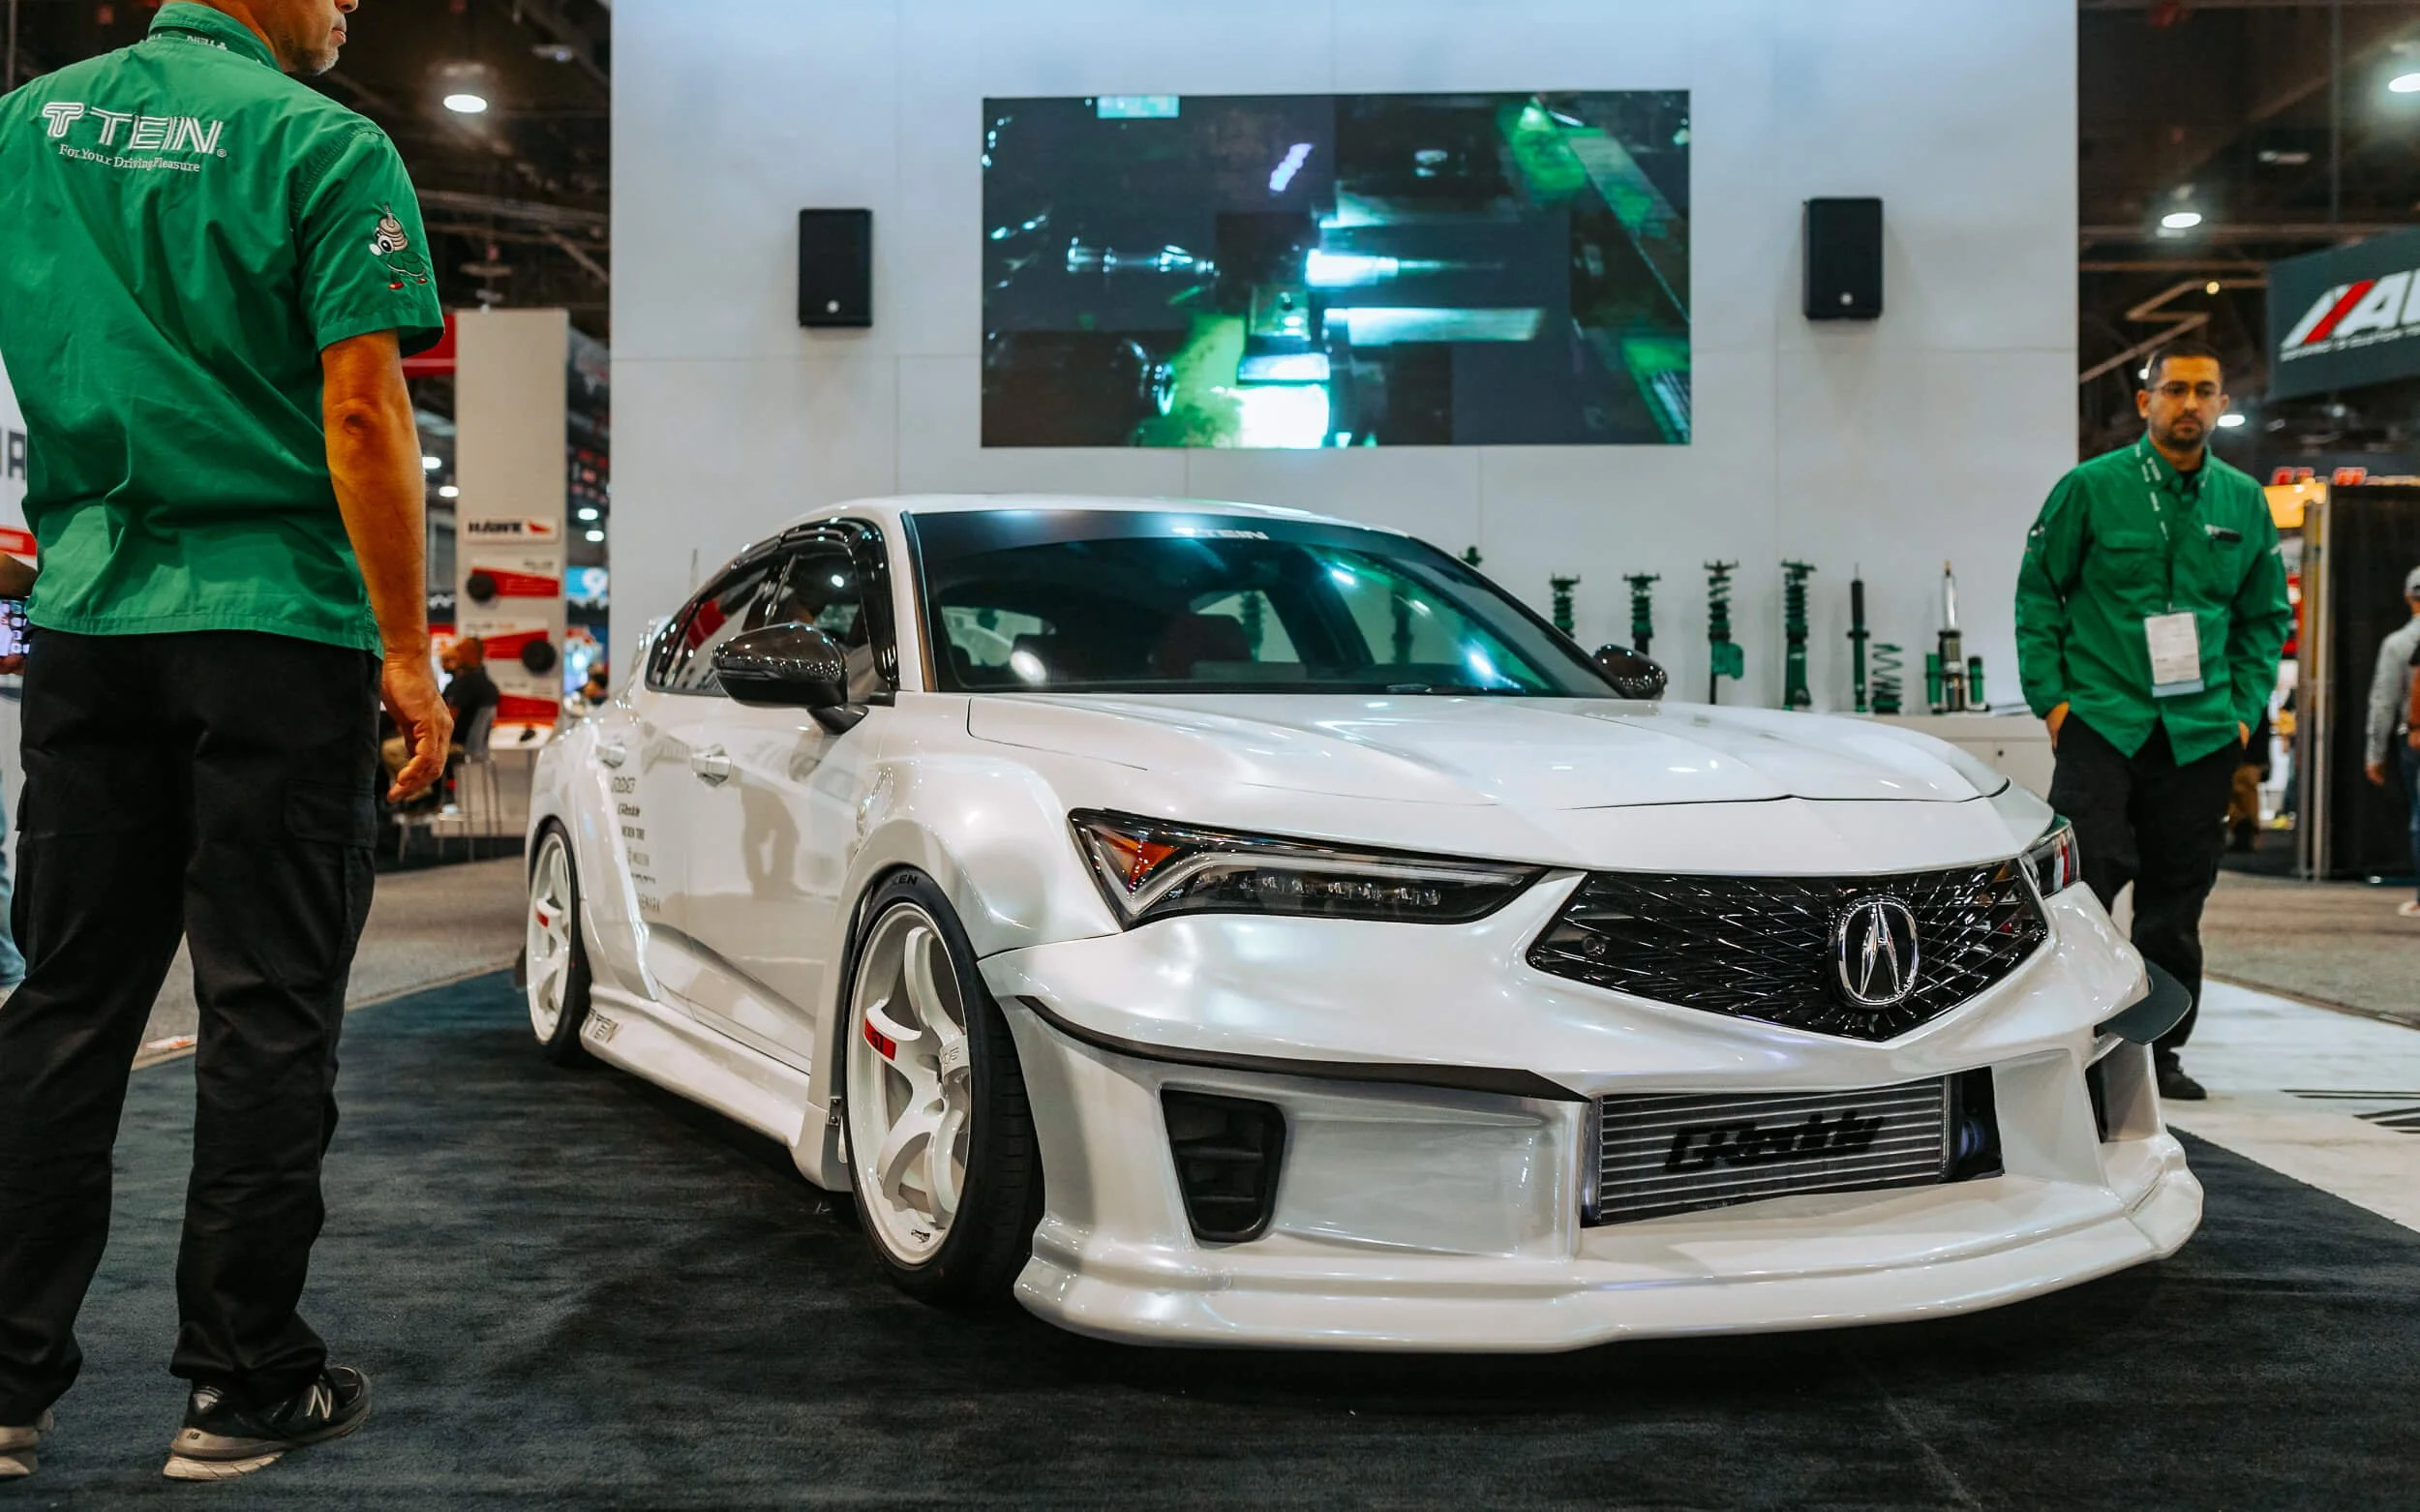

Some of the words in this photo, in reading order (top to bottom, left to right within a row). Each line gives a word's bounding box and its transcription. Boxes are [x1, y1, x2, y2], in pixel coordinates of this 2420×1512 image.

[58, 144, 80, 158] For
[81, 149, 112, 166] Your
[114, 157, 154, 171] Driving
[154, 157, 200, 172] Pleasure
